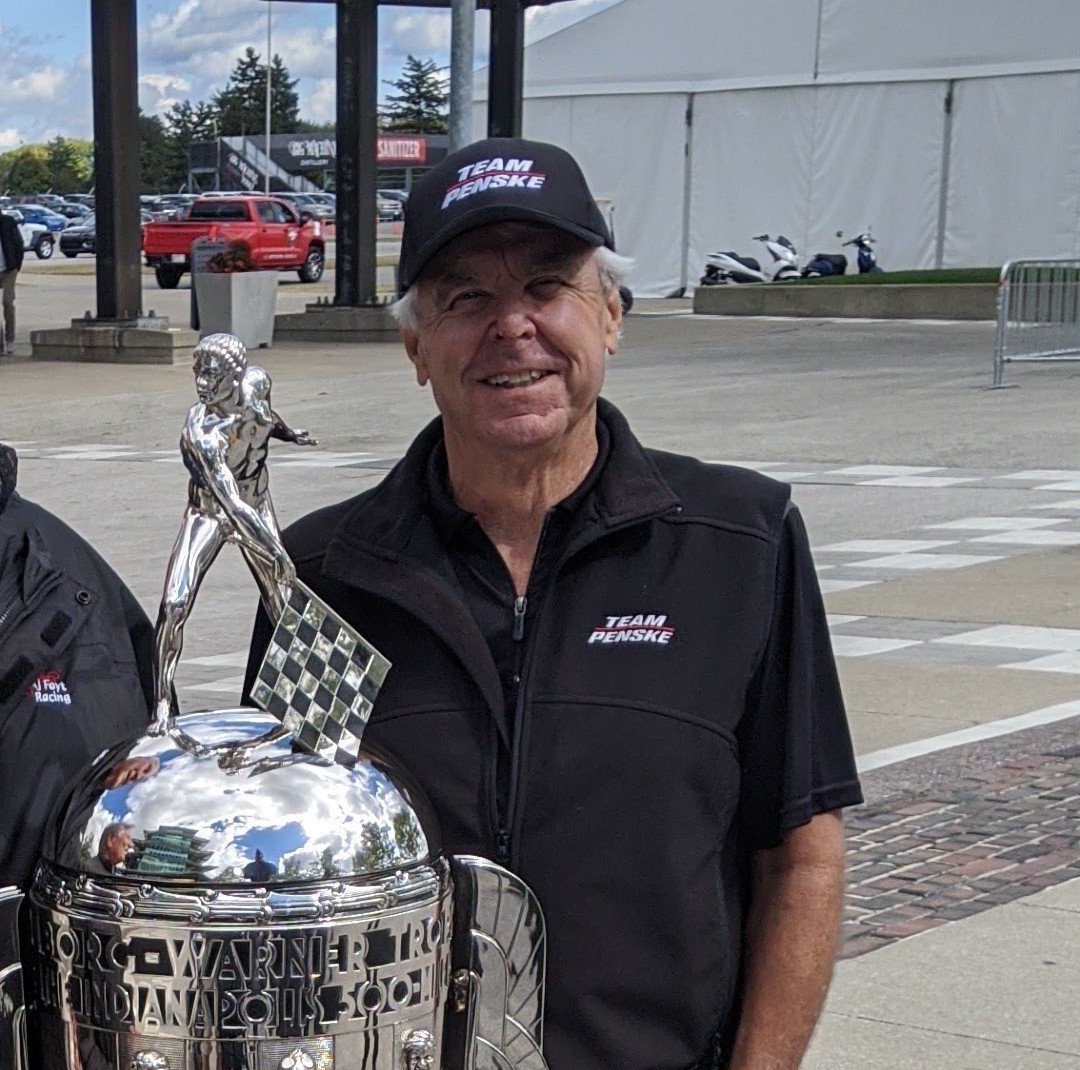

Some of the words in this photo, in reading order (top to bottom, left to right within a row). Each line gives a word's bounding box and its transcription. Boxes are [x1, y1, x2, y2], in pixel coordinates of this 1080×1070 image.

[458, 157, 533, 182] TEAM
[441, 174, 545, 209] PENSKE
[606, 614, 667, 628] TEAM
[588, 629, 674, 644] PENSKE
[43, 679, 67, 693] Foyt
[35, 690, 71, 704] Racing
